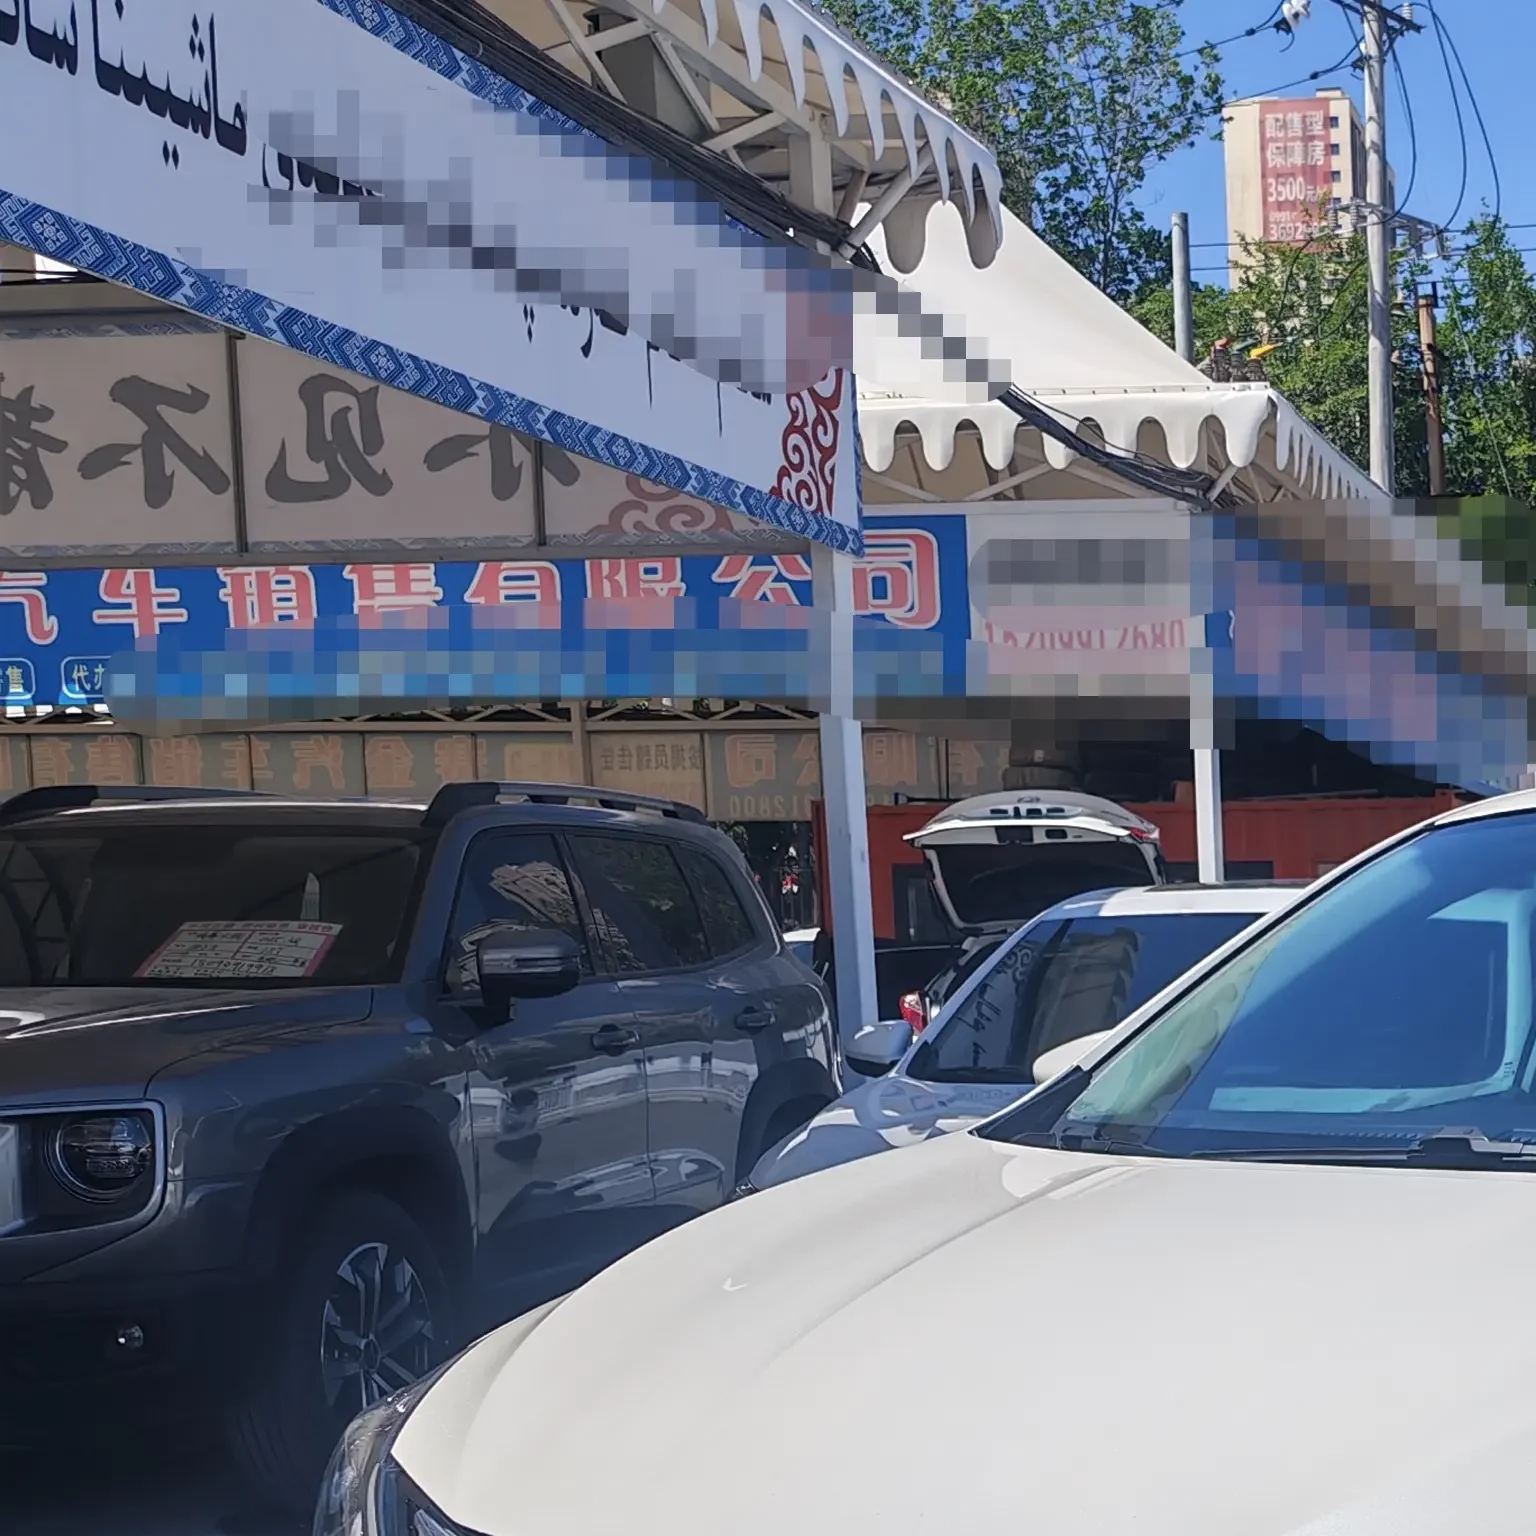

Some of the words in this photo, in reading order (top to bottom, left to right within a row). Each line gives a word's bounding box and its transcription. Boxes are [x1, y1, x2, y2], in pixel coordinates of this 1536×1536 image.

[1264, 111, 1325, 138] 配售型
[1266, 141, 1327, 168] 保障房
